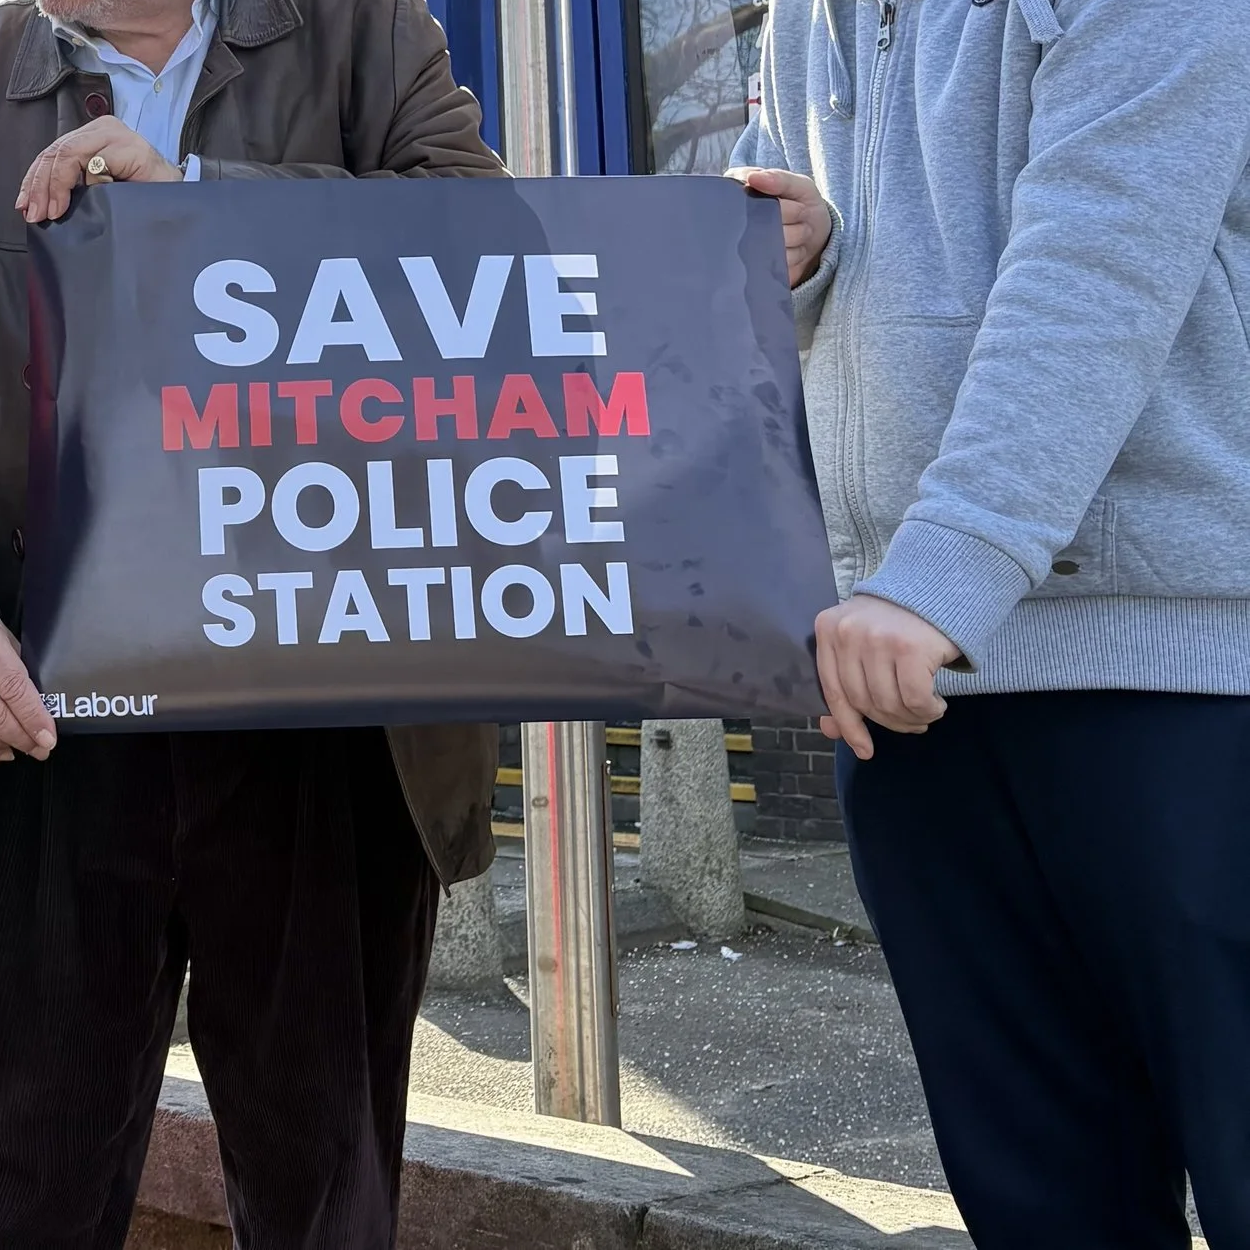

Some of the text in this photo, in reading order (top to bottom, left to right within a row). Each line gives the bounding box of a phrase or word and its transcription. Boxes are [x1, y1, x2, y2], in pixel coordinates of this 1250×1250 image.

[193, 254, 607, 367] SAVE
[161, 371, 651, 451] MITCHAM
[197, 454, 626, 556] POLICE
[201, 561, 635, 647] STATION
[60, 691, 158, 718] Labour
